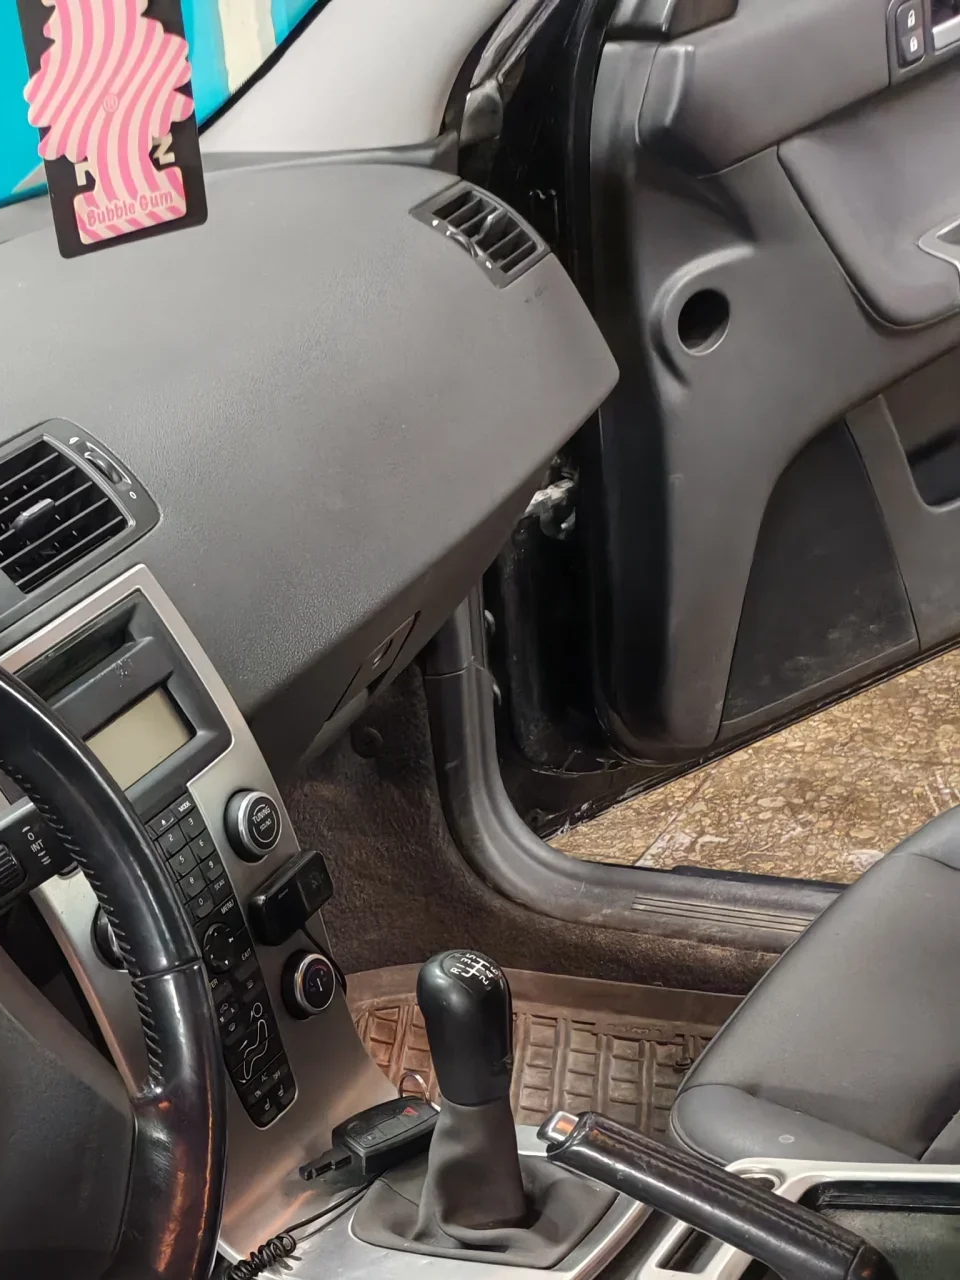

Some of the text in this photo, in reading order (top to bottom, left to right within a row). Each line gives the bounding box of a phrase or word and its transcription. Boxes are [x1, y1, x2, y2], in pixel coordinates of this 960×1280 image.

[86, 190, 174, 227] Bubble Gum
[252, 805, 271, 824] TUNING
[30, 839, 45, 853] INT
[220, 899, 235, 915] MENU
[450, 967, 462, 975] R
[486, 970, 494, 978] 4
[479, 975, 489, 985] 2
